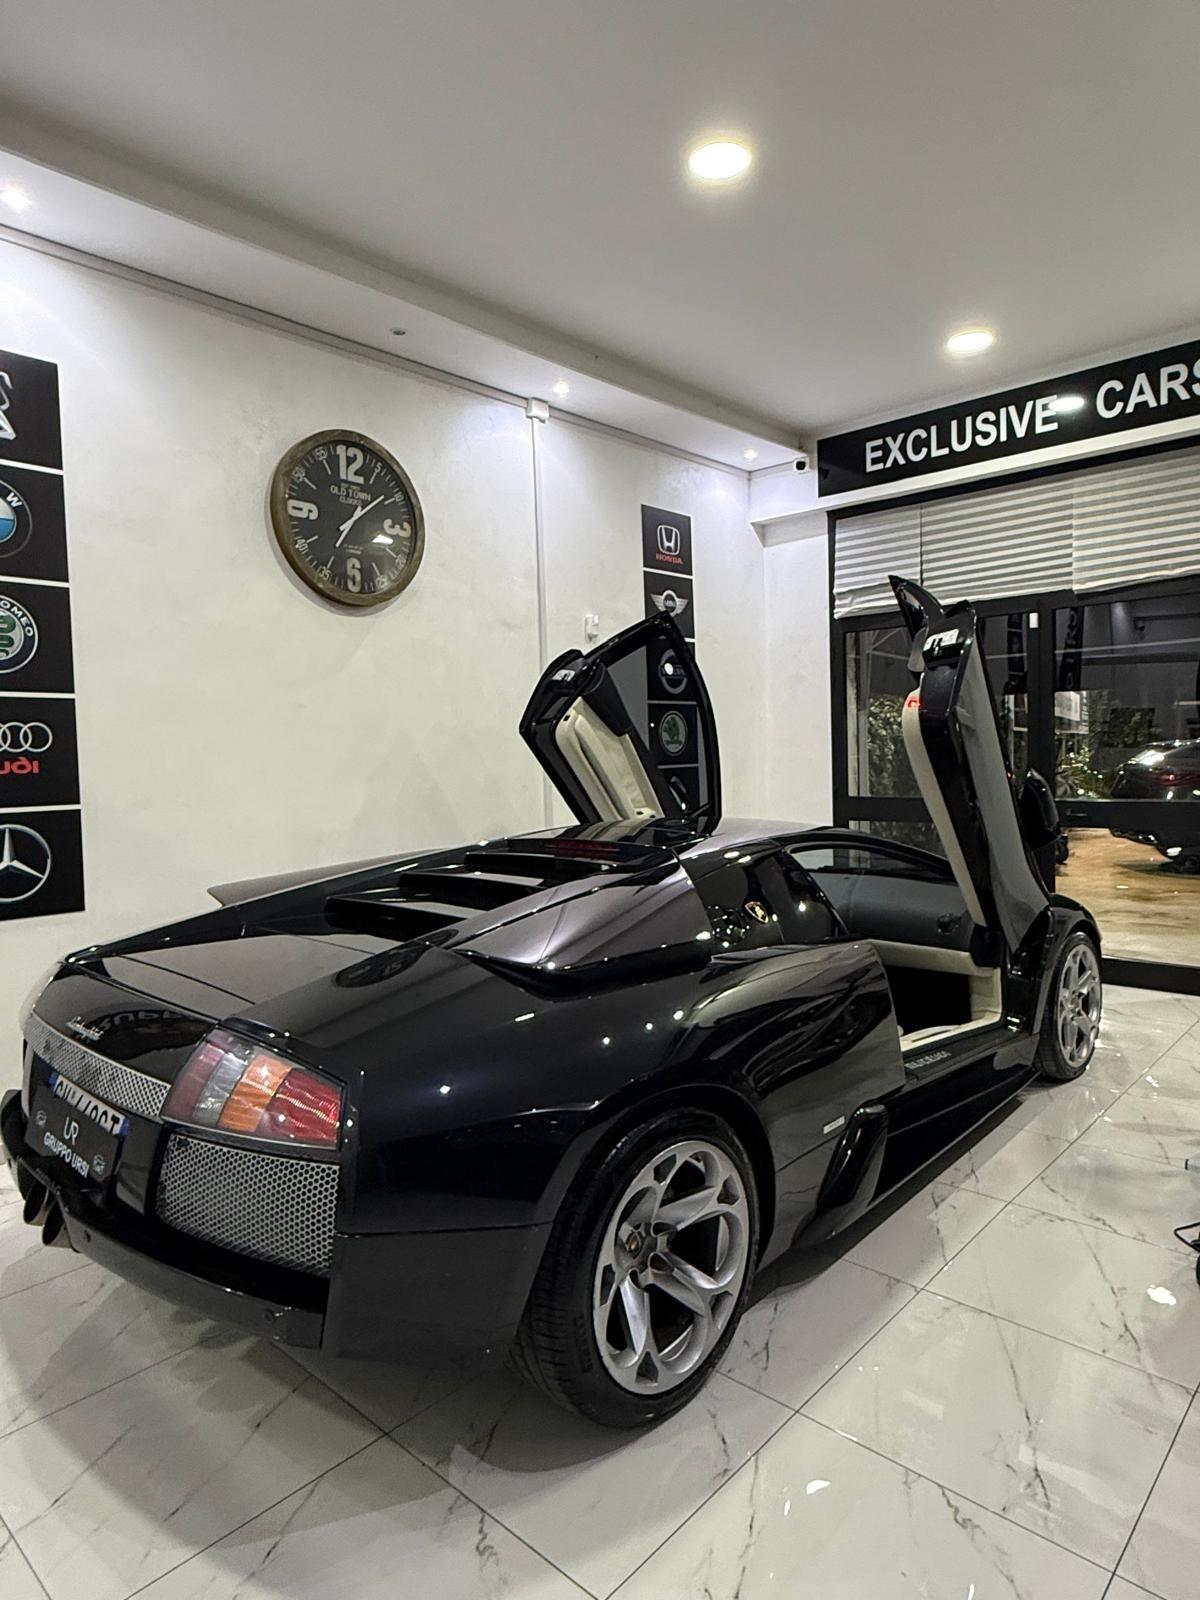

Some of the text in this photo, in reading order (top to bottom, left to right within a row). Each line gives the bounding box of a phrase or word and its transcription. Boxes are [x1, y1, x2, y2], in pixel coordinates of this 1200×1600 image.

[865, 395, 1058, 472] EXCLUSIVE
[336, 444, 364, 484] 12
[330, 485, 346, 495] OLD
[348, 489, 371, 501] TOWN
[287, 499, 318, 520] 9
[383, 518, 411, 537] 3
[655, 552, 684, 565] HONDA
[346, 557, 362, 592] 6
[43, 1131, 72, 1163] GRUPPO
[71, 1153, 90, 1178] URSI
